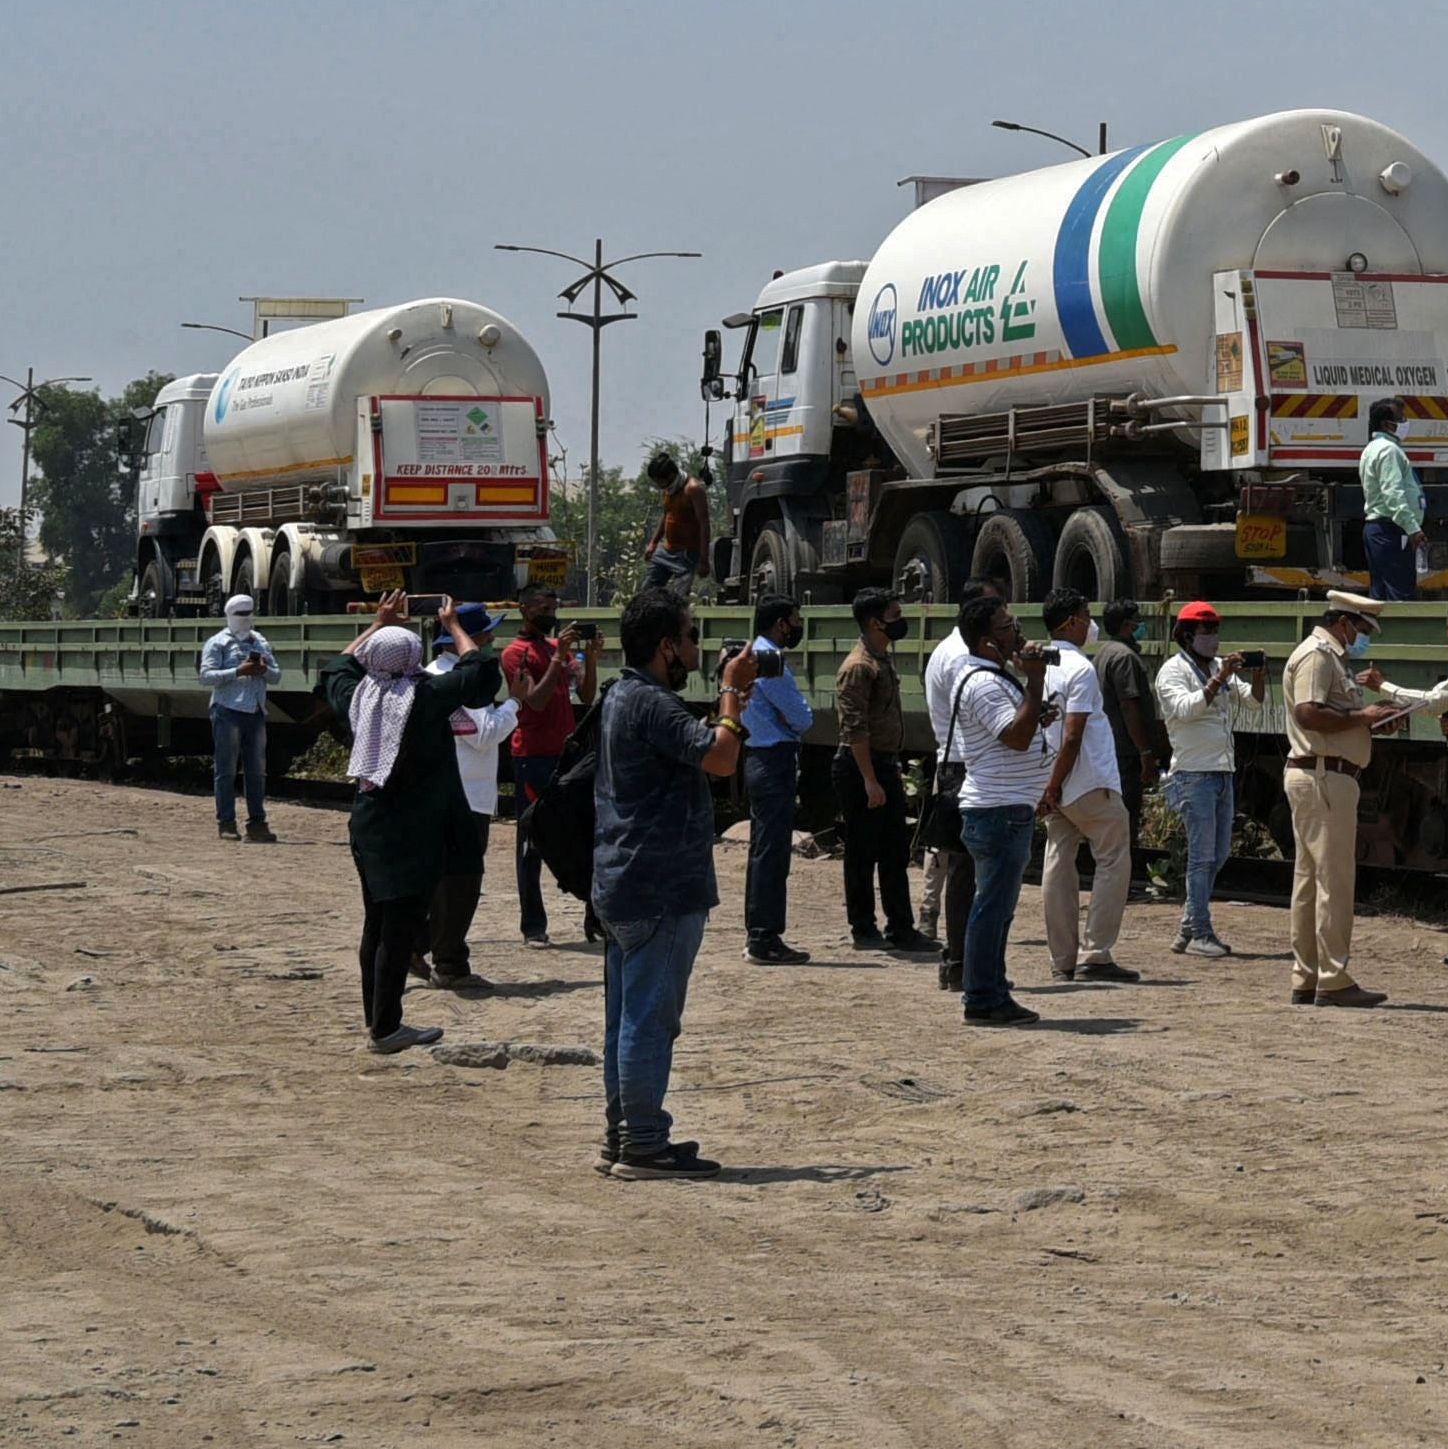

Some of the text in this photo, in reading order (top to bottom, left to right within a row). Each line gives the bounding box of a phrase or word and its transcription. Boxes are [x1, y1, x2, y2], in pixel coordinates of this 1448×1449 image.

[917, 264, 1000, 312] INOX AIR
[902, 306, 995, 357] PRODUCTS
[1313, 365, 1348, 386] LIQUID
[1350, 366, 1395, 386] MEDICAL
[1396, 367, 1437, 386] OXYGEN
[397, 464, 422, 475] KEEP
[424, 464, 474, 476] DISTANCE
